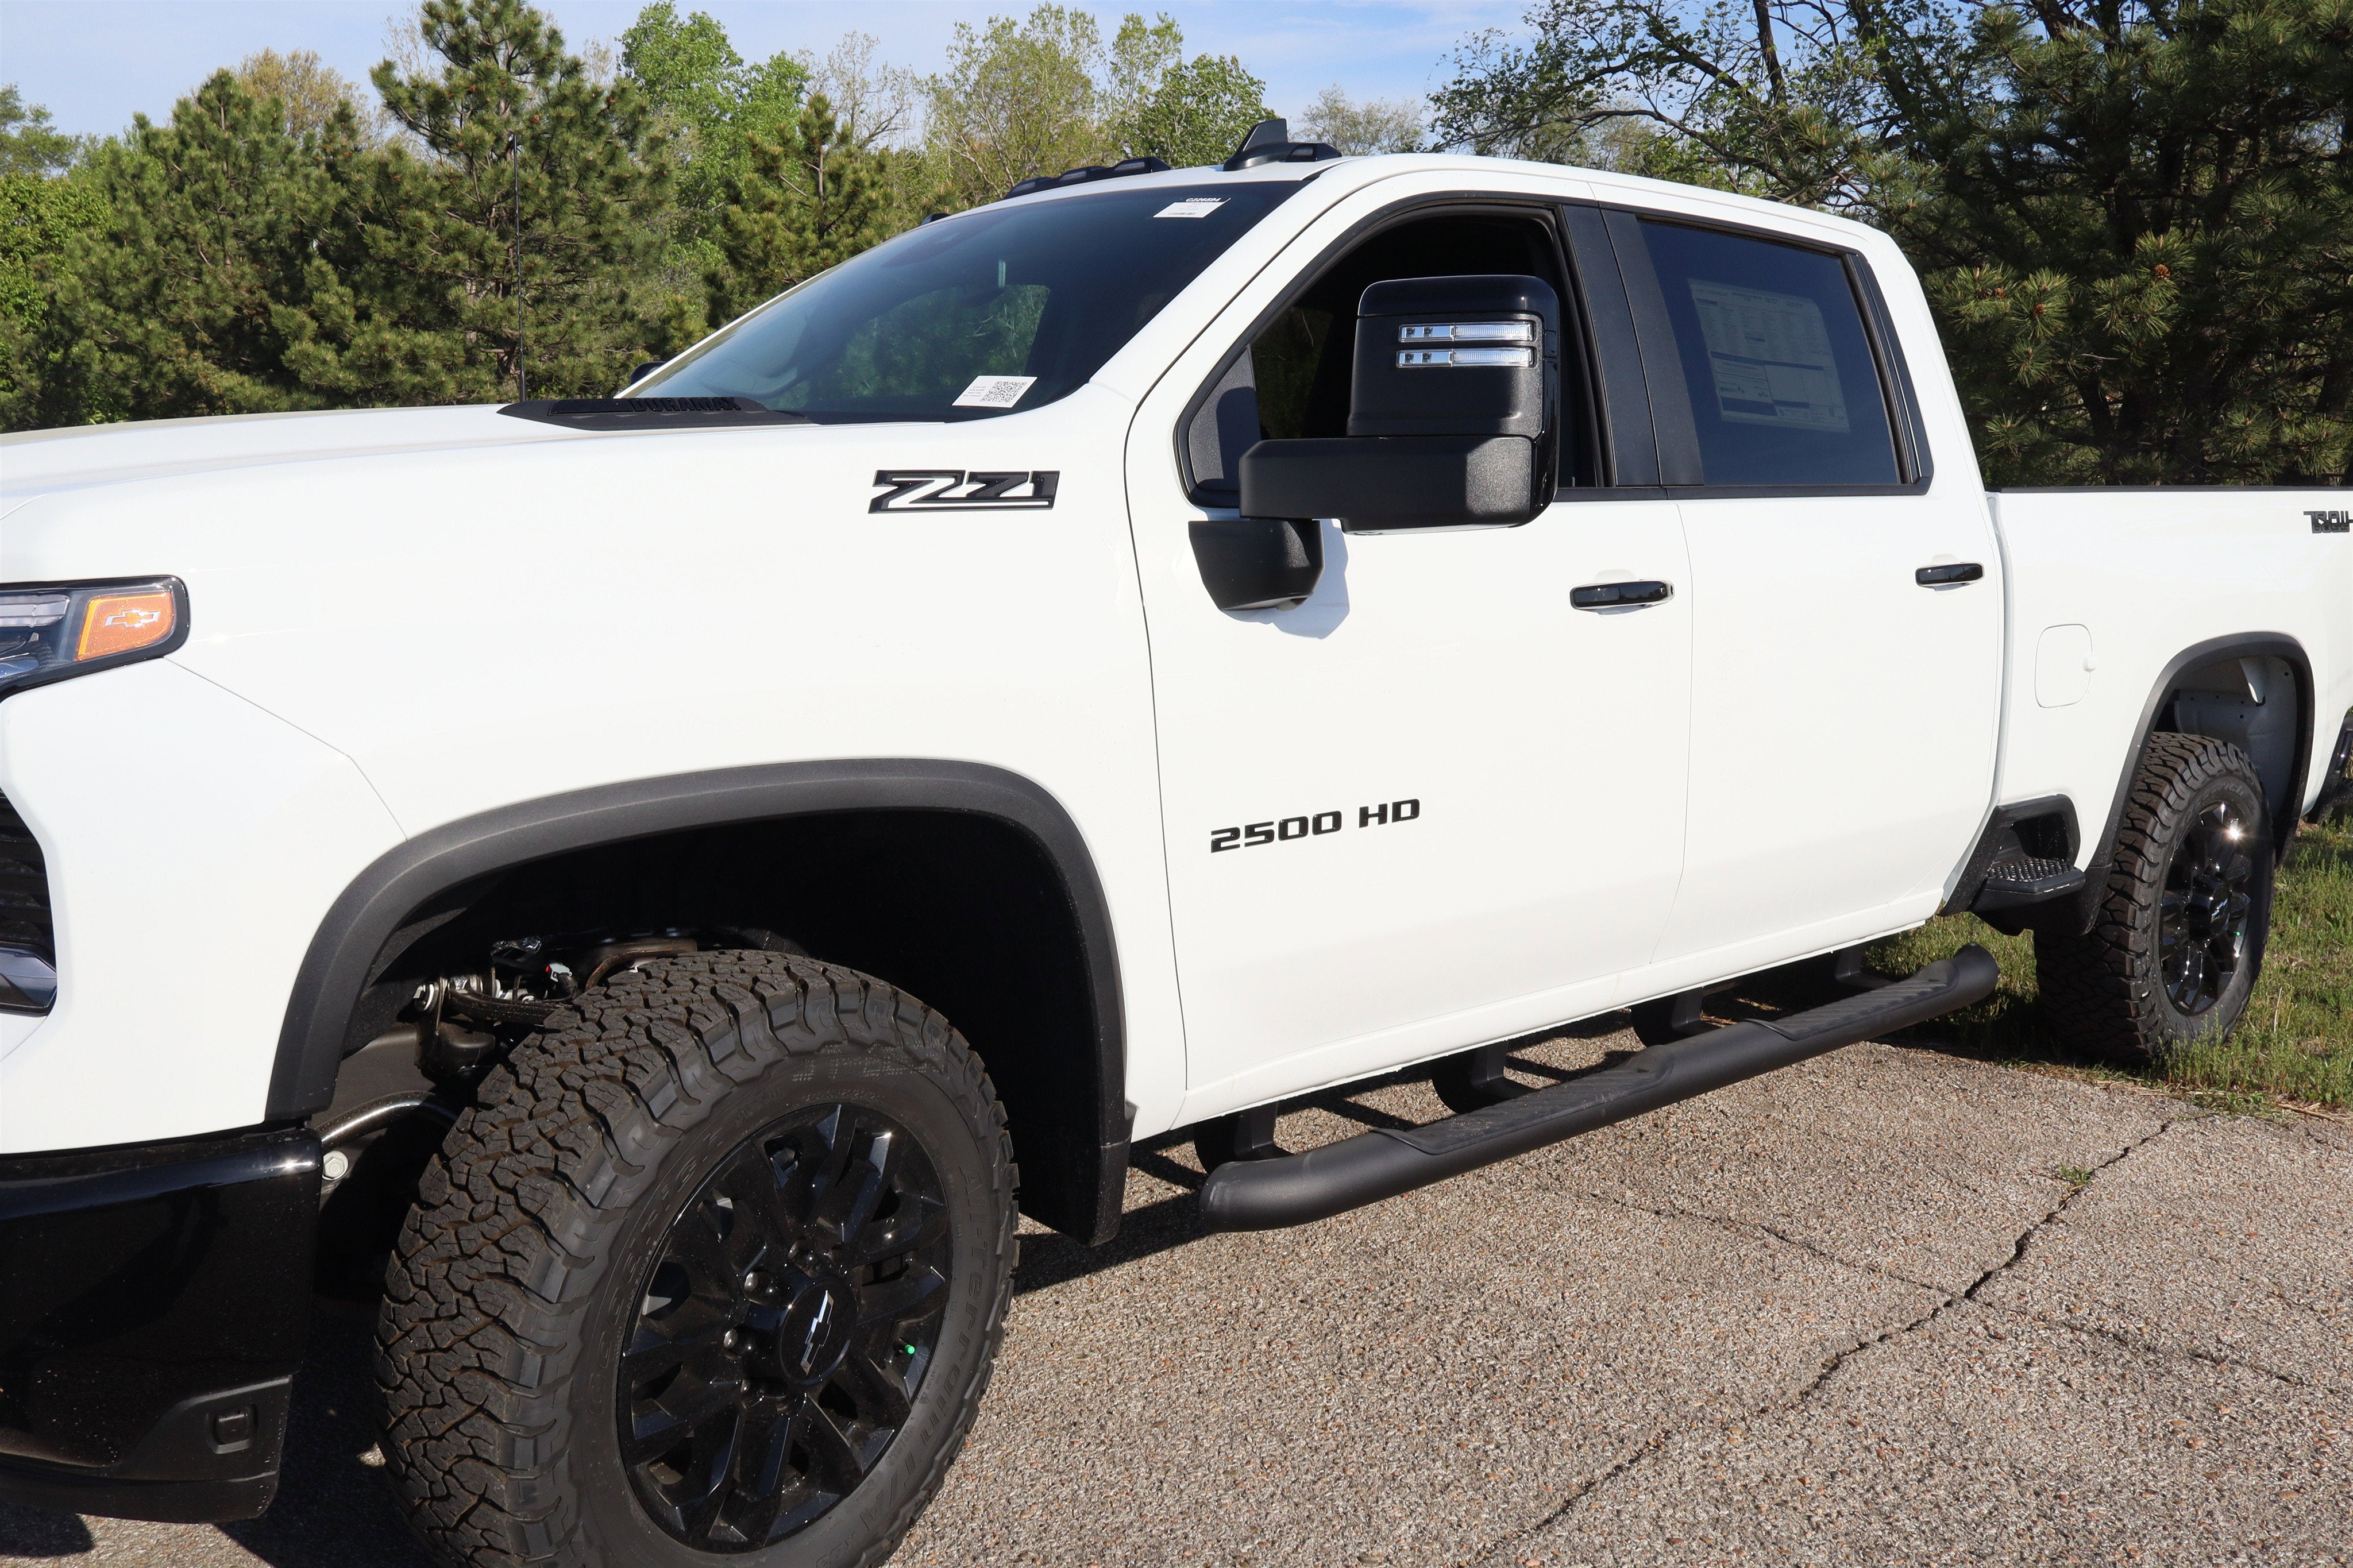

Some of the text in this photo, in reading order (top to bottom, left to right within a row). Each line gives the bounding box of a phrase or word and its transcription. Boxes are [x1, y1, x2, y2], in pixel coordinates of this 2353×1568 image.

[627, 396, 742, 411] DURAMAX
[867, 469, 1060, 514] Z71
[1210, 798, 1420, 853] 2500 HD
